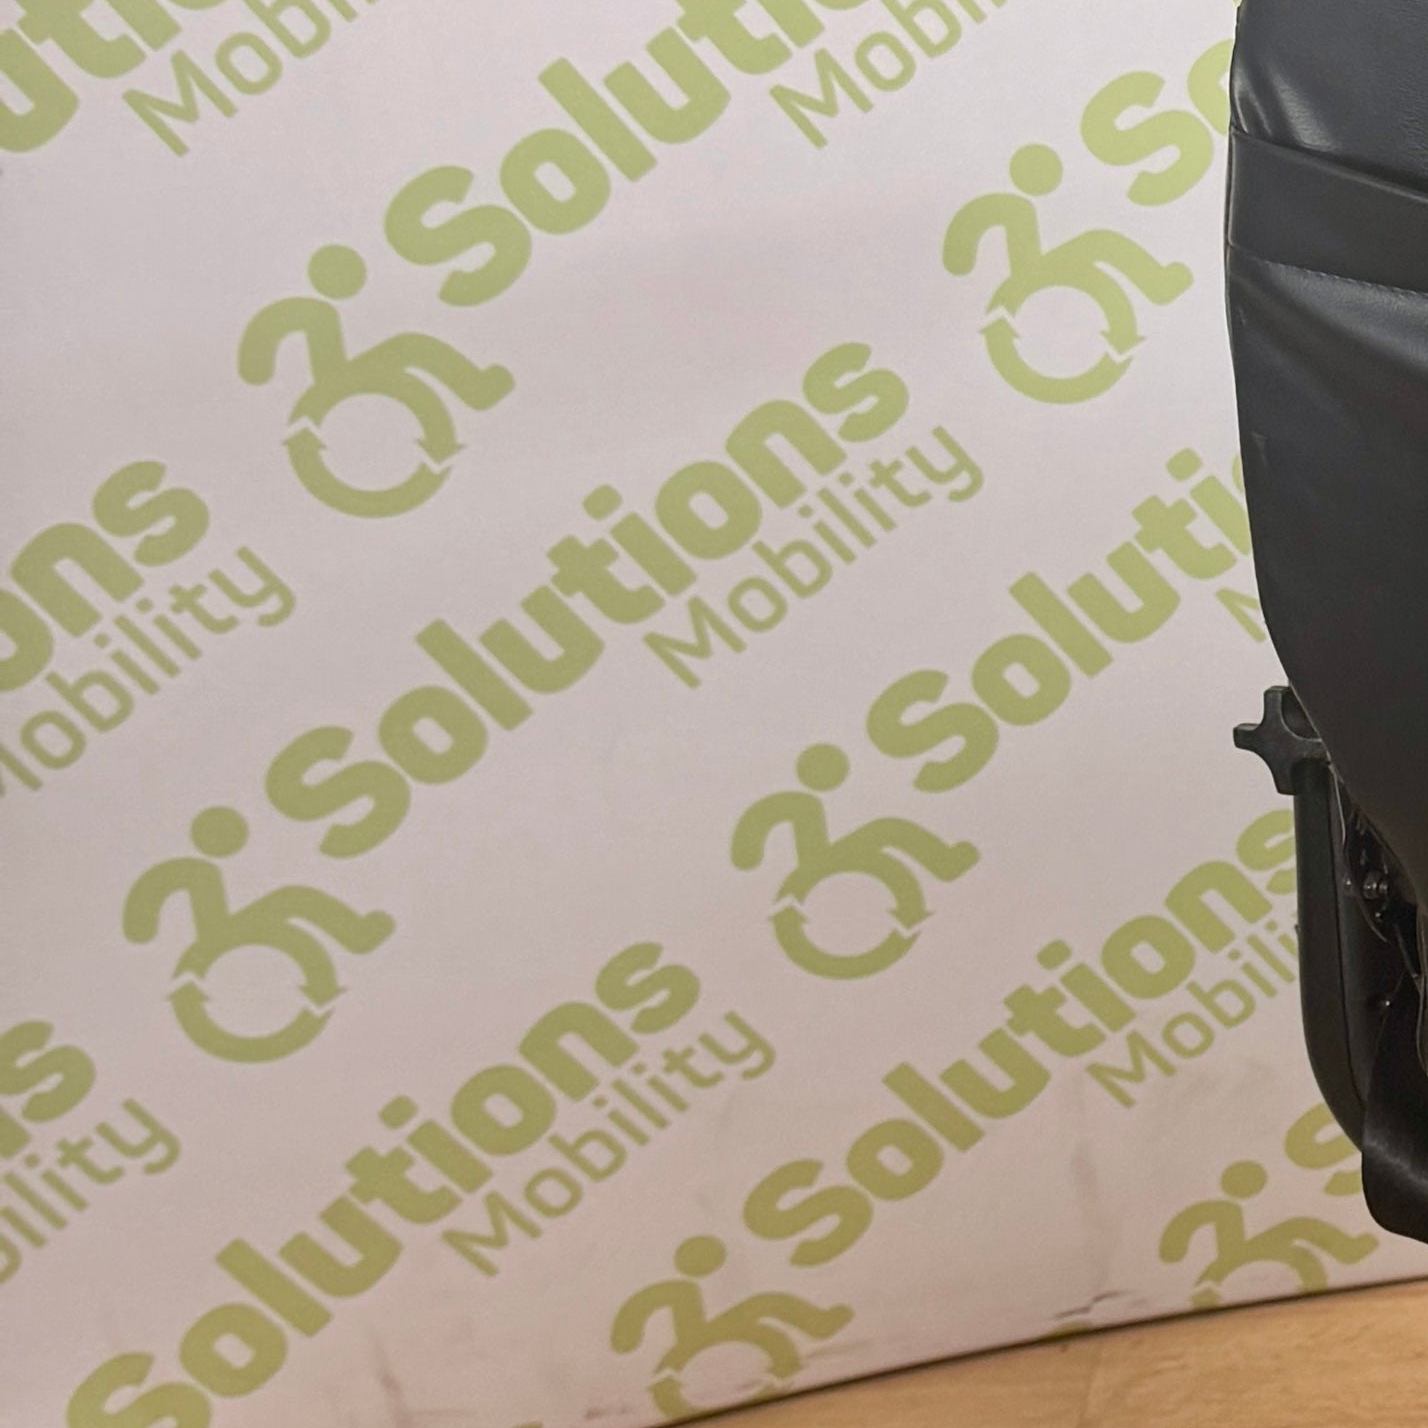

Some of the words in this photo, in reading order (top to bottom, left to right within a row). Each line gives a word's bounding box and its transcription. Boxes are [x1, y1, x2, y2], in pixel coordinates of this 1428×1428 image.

[264, 342, 908, 859] Solutions
[643, 427, 983, 688] Mobility
[864, 448, 1254, 794] Soluti
[441, 1012, 775, 1276] Mobility
